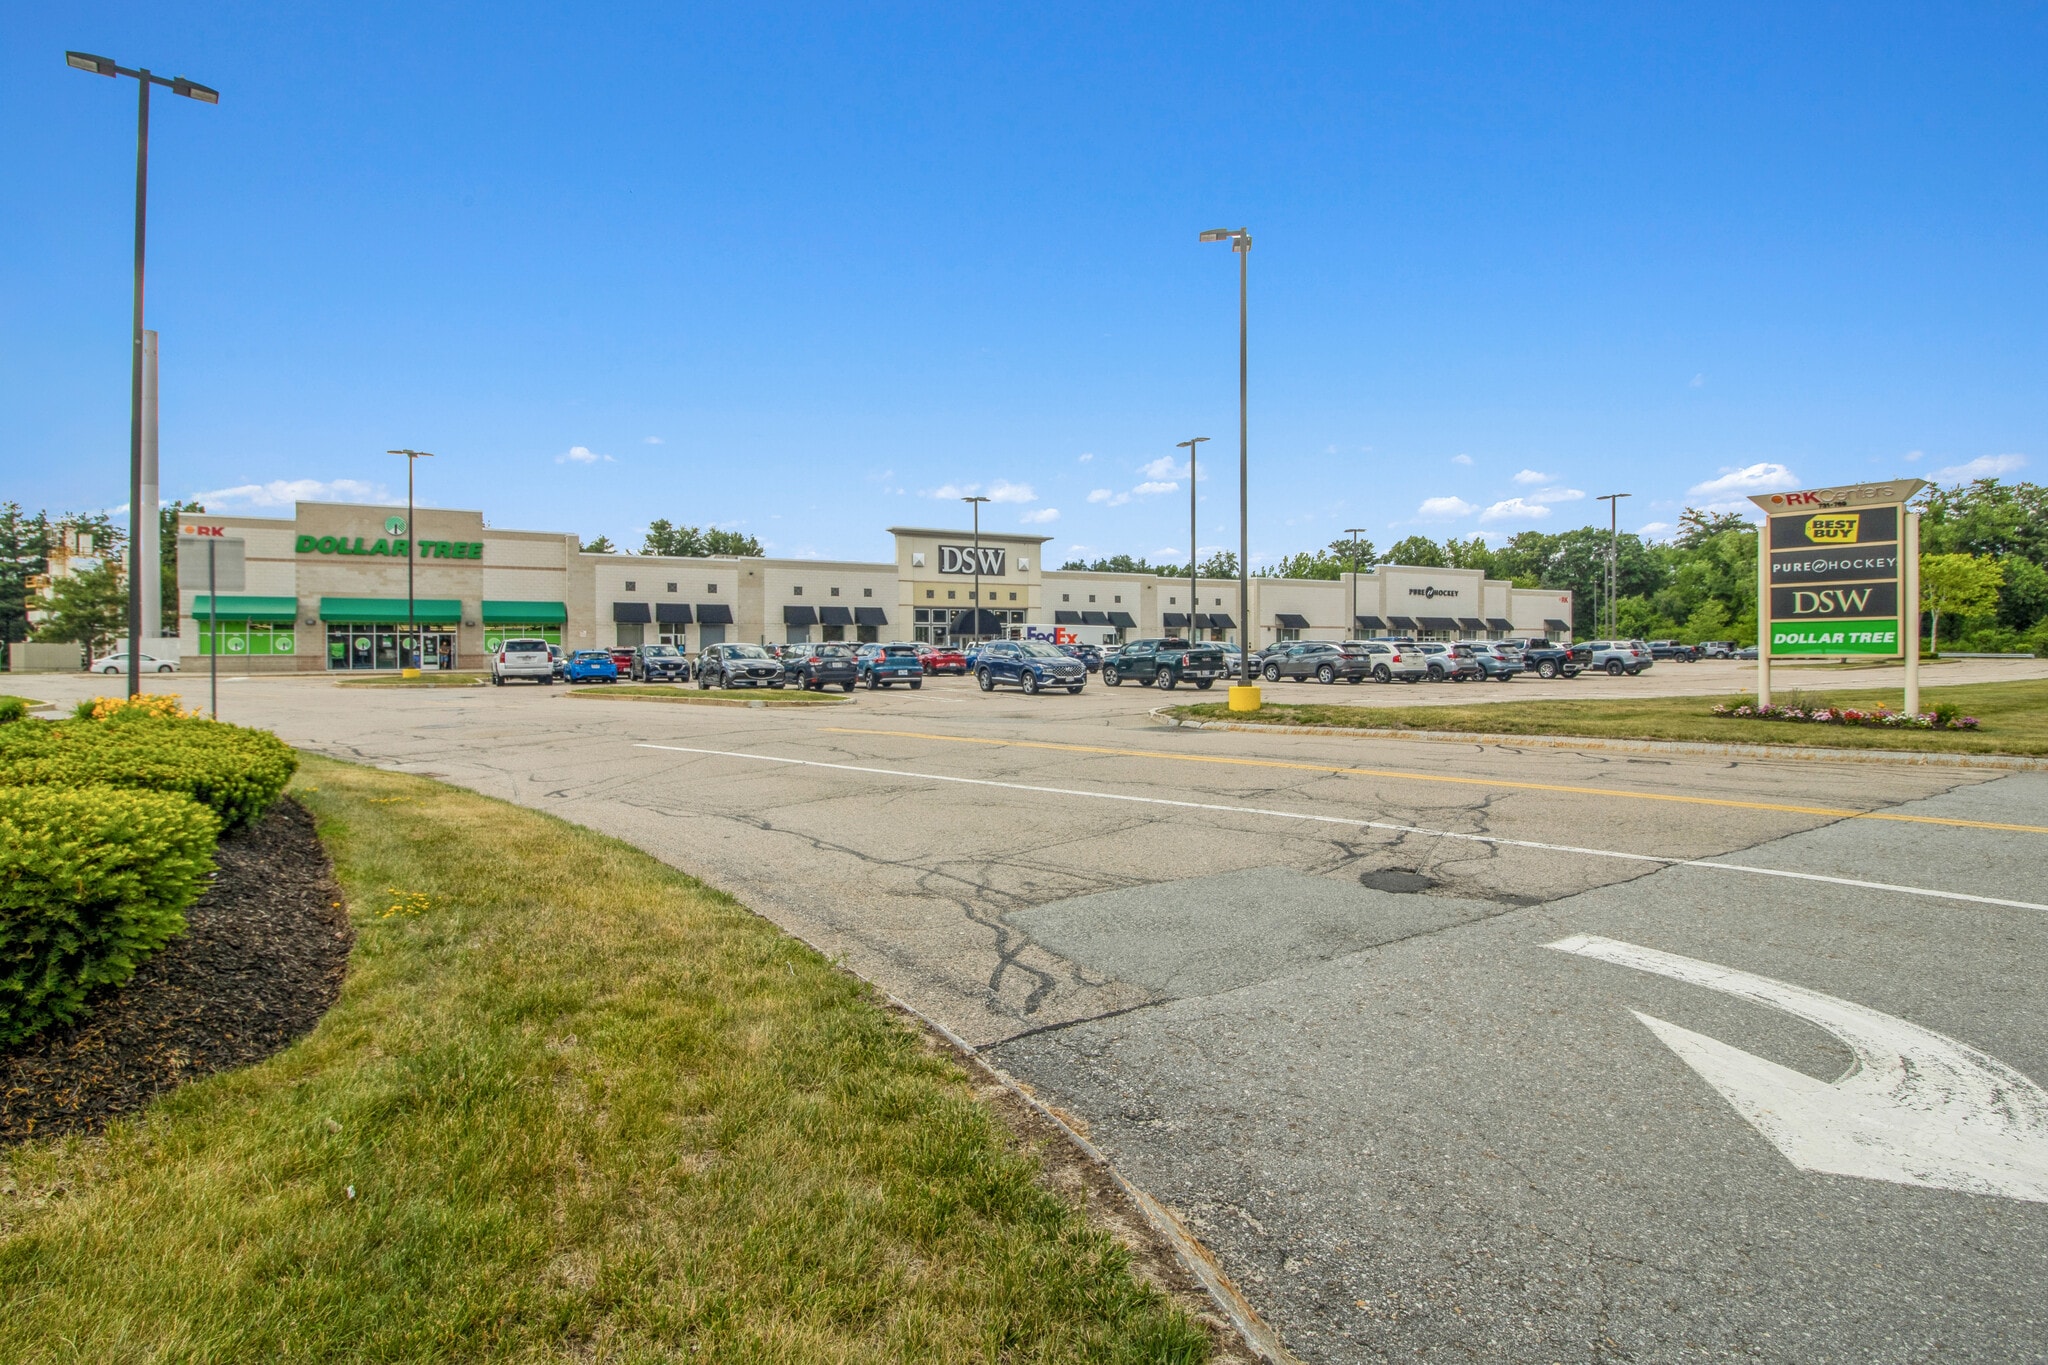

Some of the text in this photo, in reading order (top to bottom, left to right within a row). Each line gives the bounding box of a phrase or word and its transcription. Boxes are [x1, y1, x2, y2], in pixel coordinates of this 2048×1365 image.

[1812, 519, 1857, 529] BEST
[197, 526, 225, 537] RK
[1813, 529, 1853, 538] BUY
[294, 535, 484, 559] DOLLAR TREE
[941, 546, 1005, 575] DSW
[1772, 558, 1896, 573] PURE HOCKEY
[1408, 588, 1459, 597] PURE HOCKEY
[1792, 588, 1873, 614] DSW
[1027, 626, 1078, 645] FedEx
[1773, 632, 1896, 644] DOLLAR TREE
